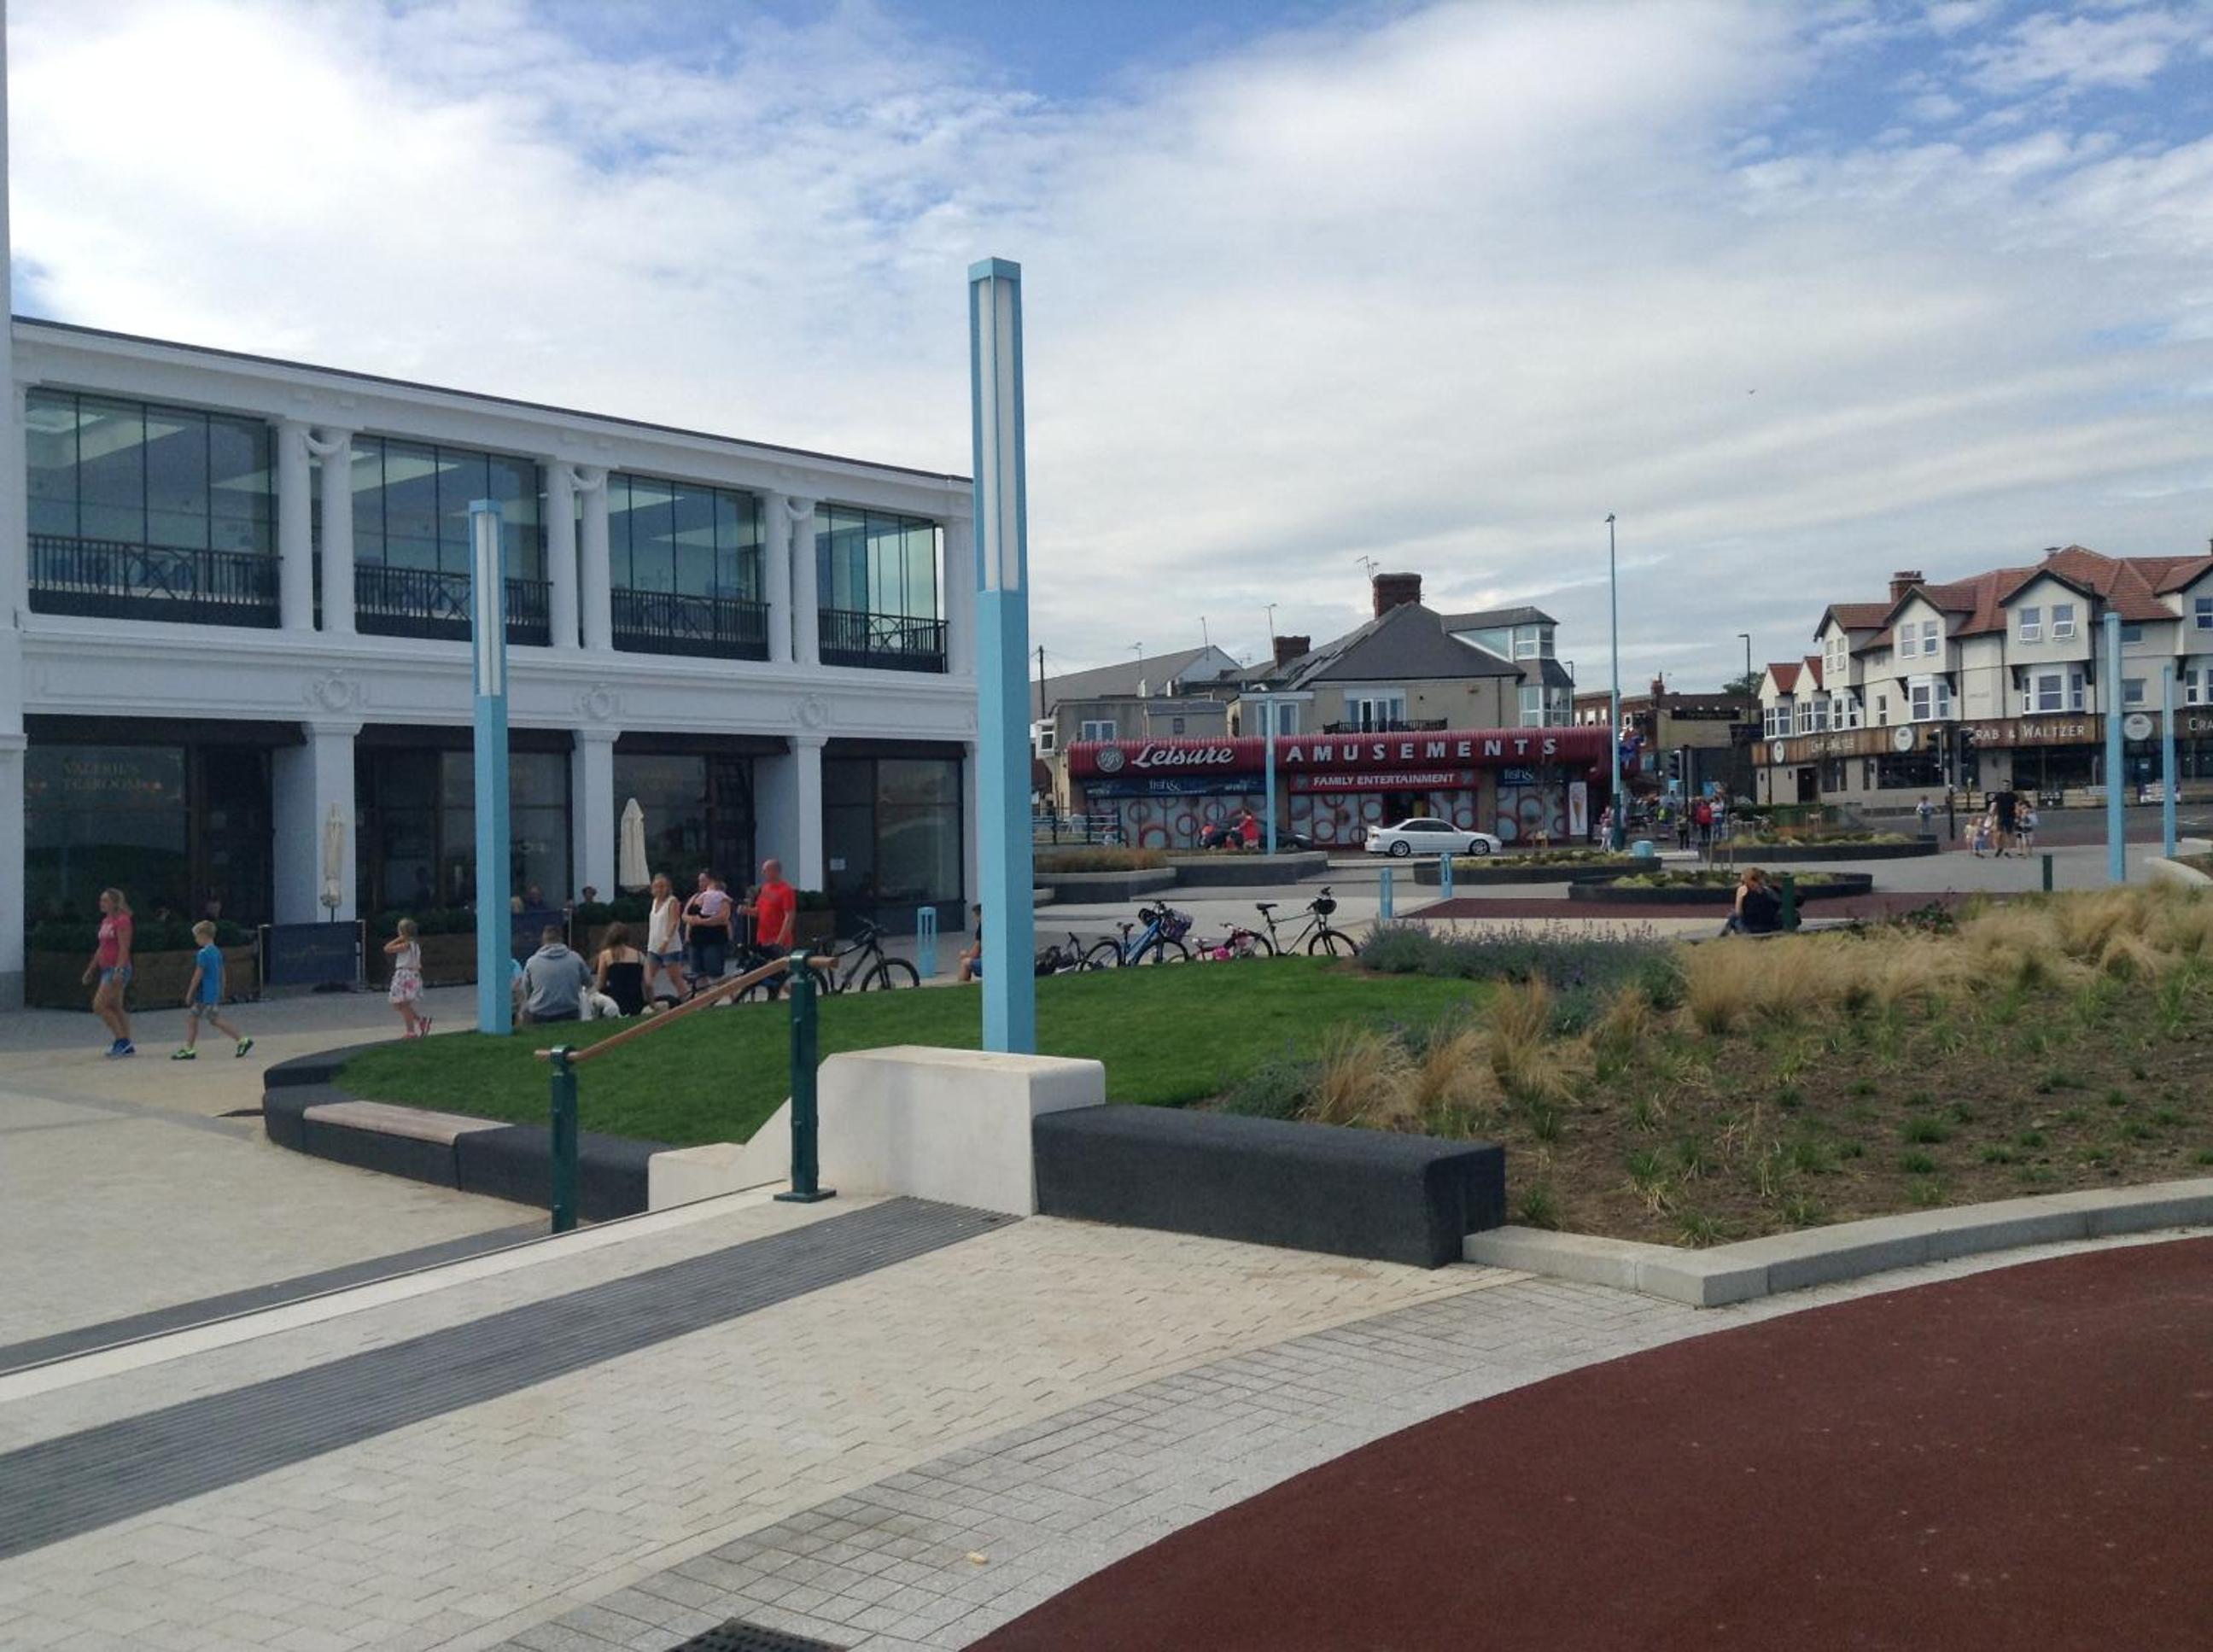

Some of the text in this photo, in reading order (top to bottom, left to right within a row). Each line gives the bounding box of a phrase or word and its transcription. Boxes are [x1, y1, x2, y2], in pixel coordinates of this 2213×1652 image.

[2009, 729, 2016, 739] &
[2023, 724, 2085, 738] WALTZER
[1131, 744, 1235, 768] Leisure
[1287, 738, 1557, 762] AMUSEMENTS
[1313, 773, 1456, 786] FAMILY ENTERTAINMENT
